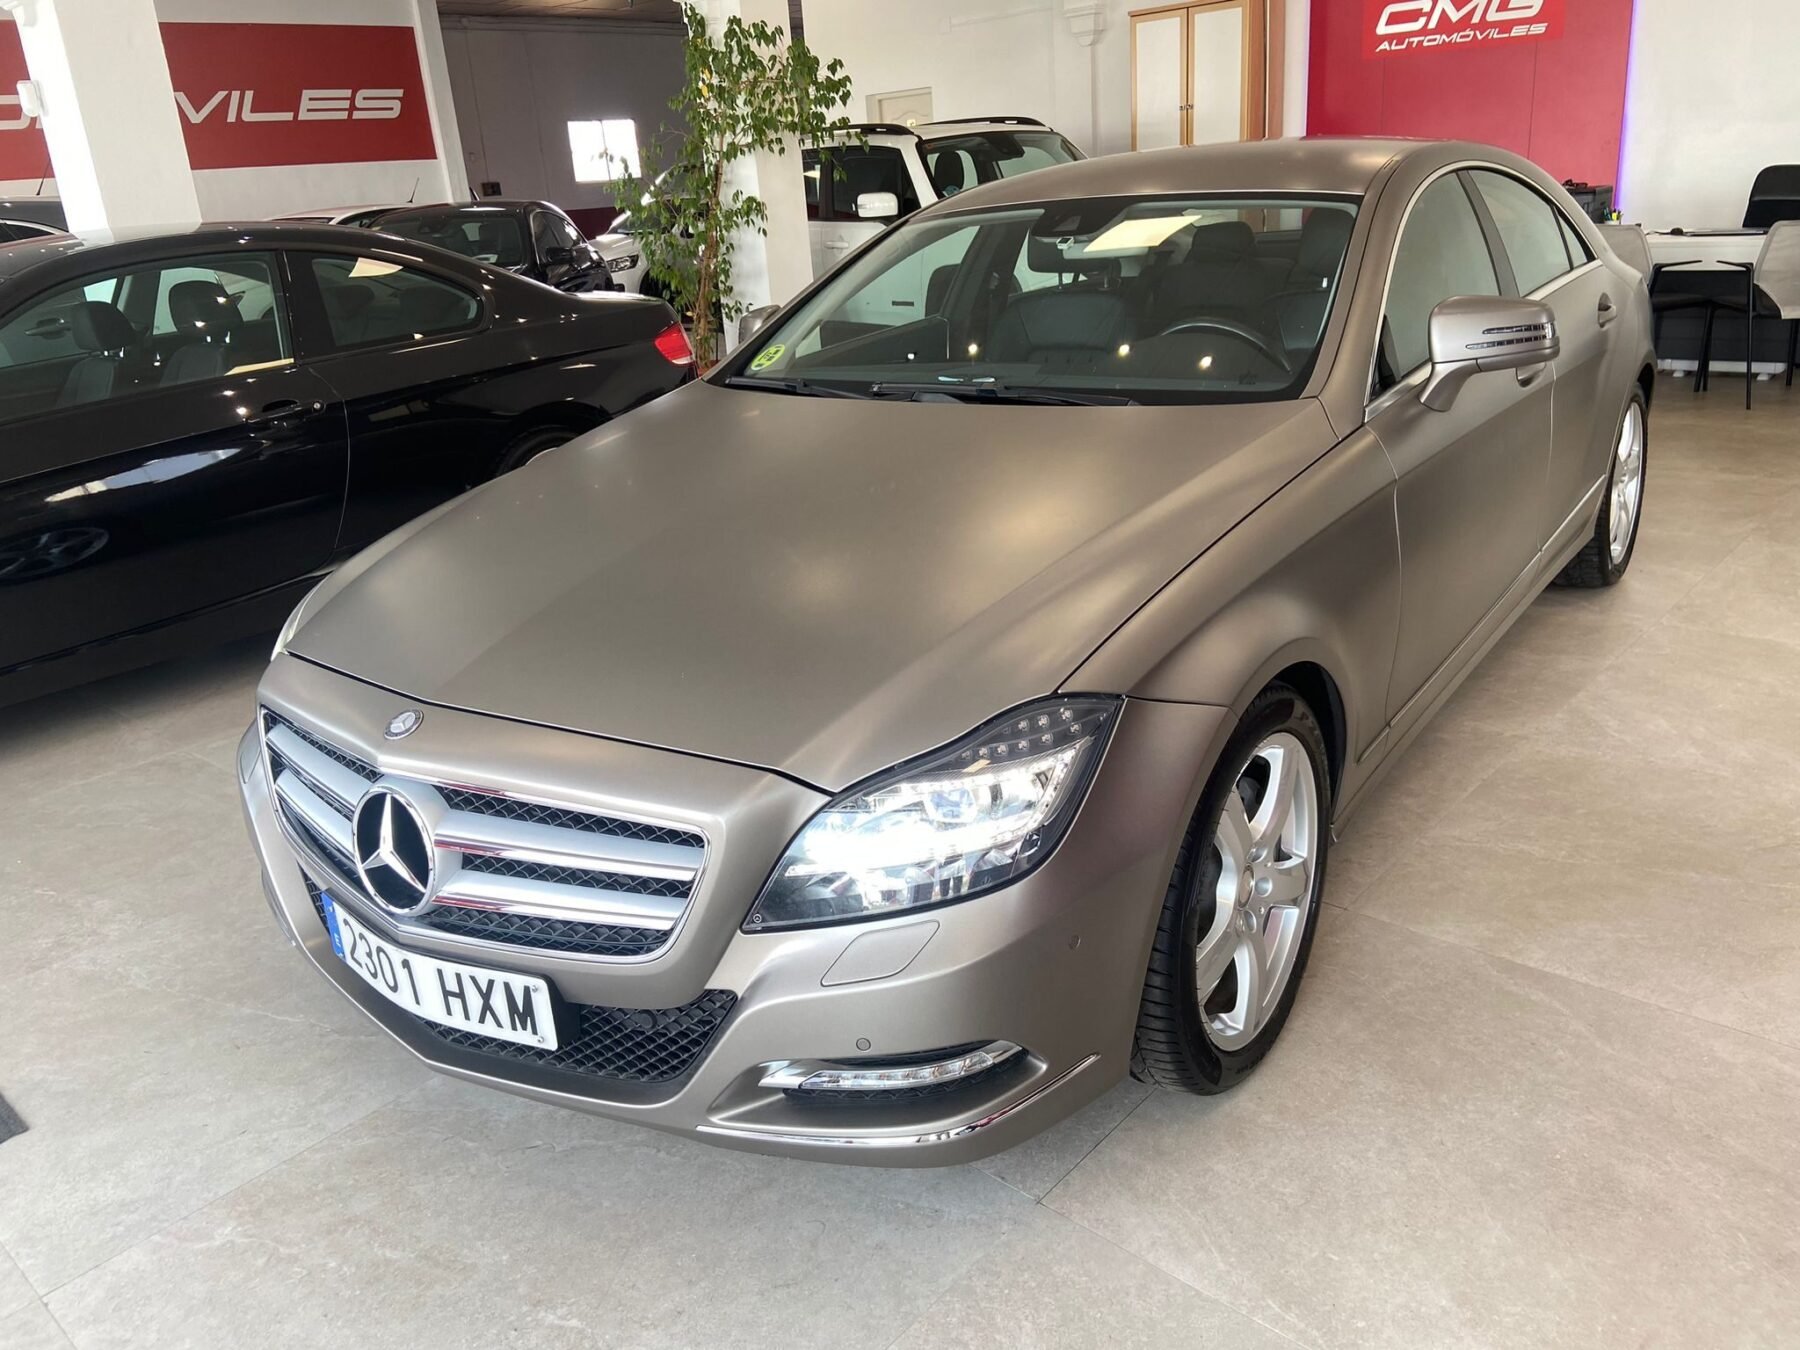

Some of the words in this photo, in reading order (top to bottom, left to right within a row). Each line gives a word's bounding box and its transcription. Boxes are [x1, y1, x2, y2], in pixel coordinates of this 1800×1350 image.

[1375, 23, 1548, 52] AUTOMÓVILES
[343, 918, 420, 1006] 2301
[437, 968, 538, 1036] HXM
